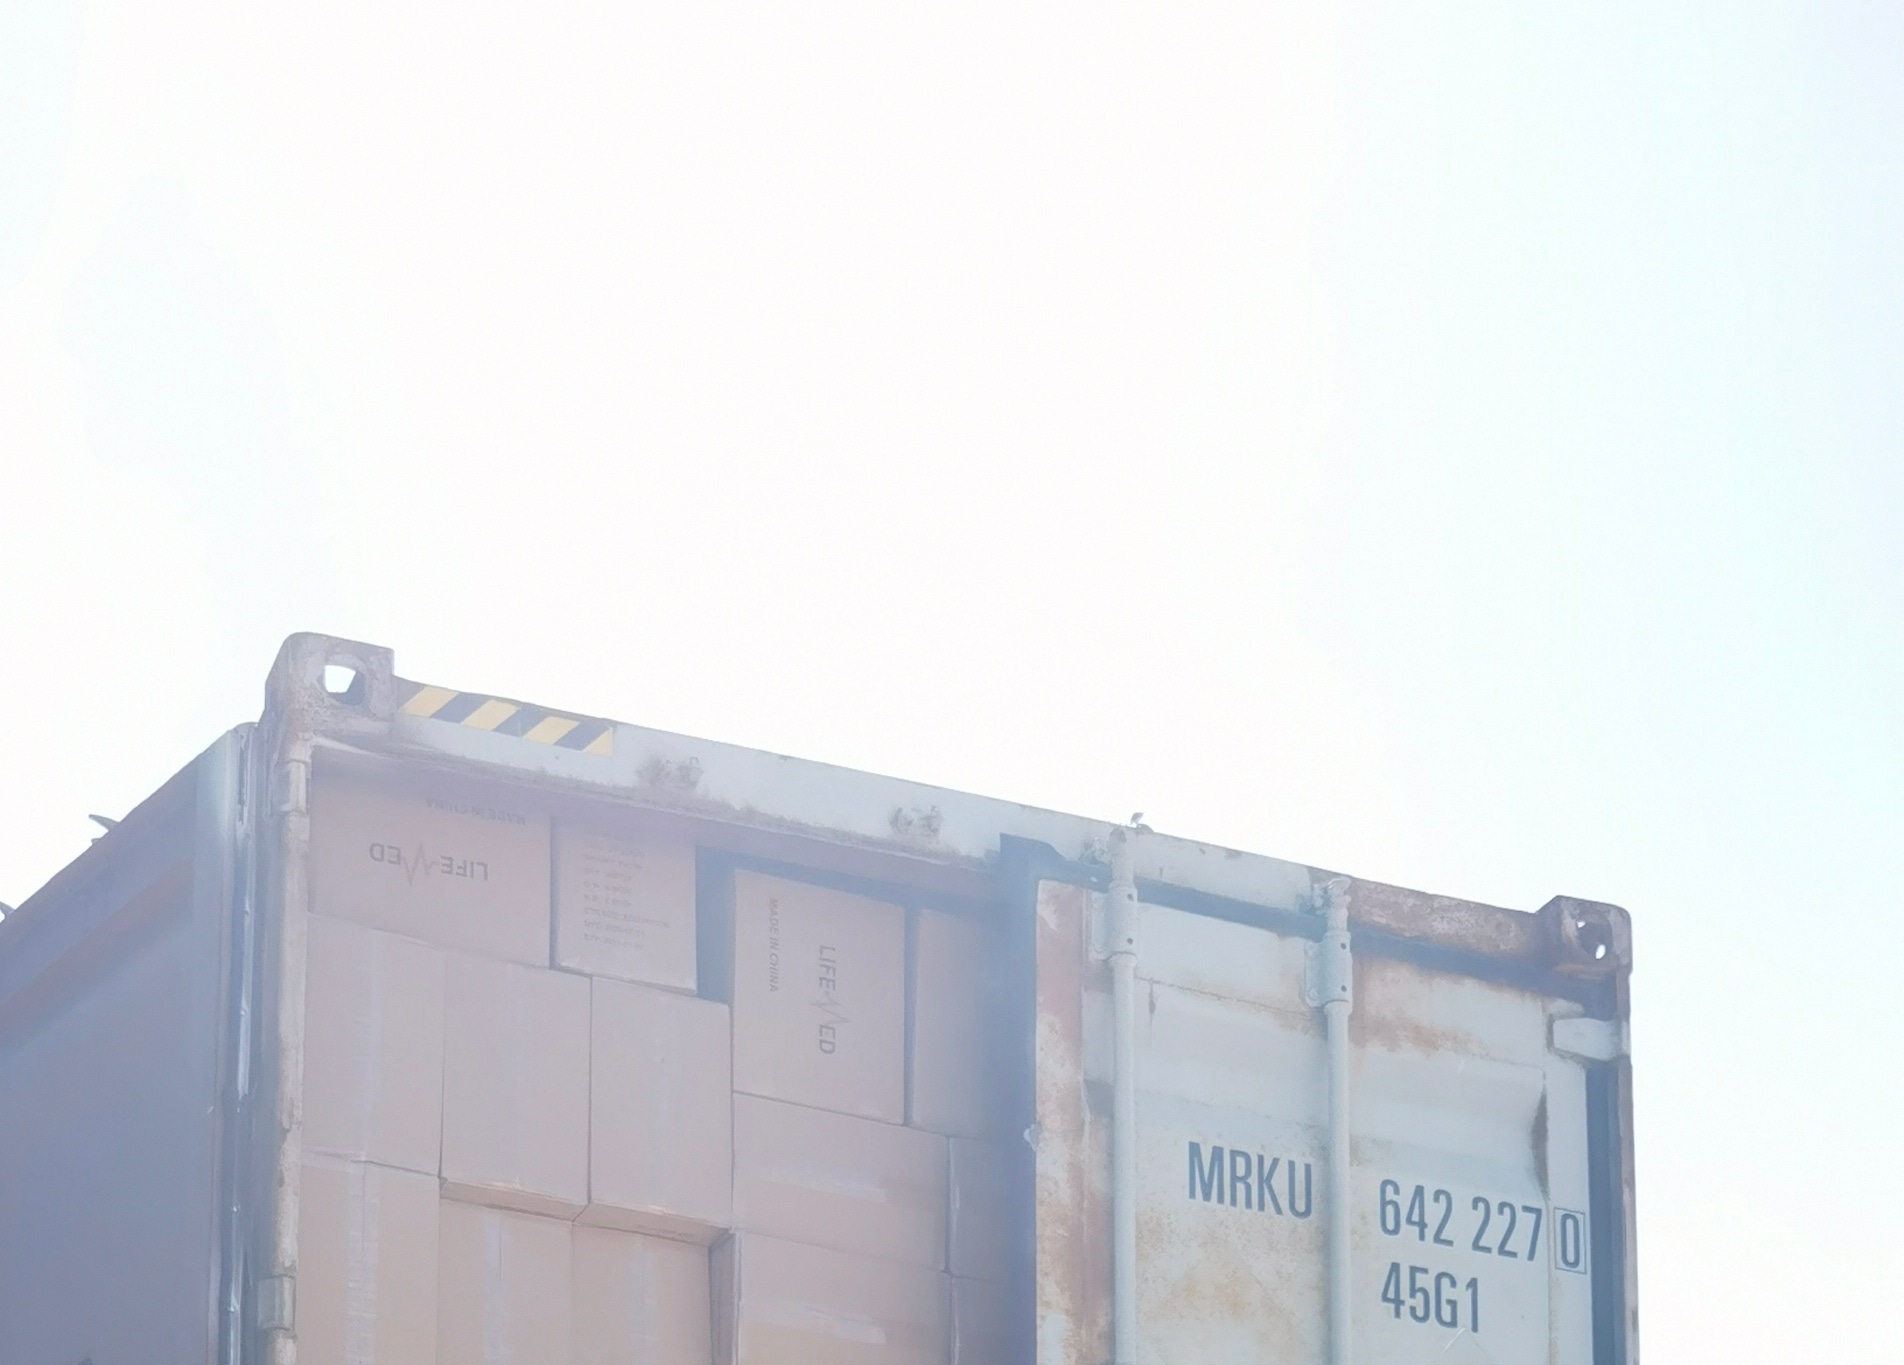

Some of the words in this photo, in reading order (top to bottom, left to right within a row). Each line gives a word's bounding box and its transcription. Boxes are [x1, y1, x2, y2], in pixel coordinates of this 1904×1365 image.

[769, 898, 780, 934] MADE
[769, 937, 780, 950] IN
[769, 952, 780, 993] CHINA
[1187, 1141, 1313, 1219] MRKU
[1379, 1178, 1454, 1247] 642
[1471, 1196, 1543, 1263] 227
[1560, 1212, 1580, 1270] 0
[1381, 1261, 1479, 1334] 45G1
